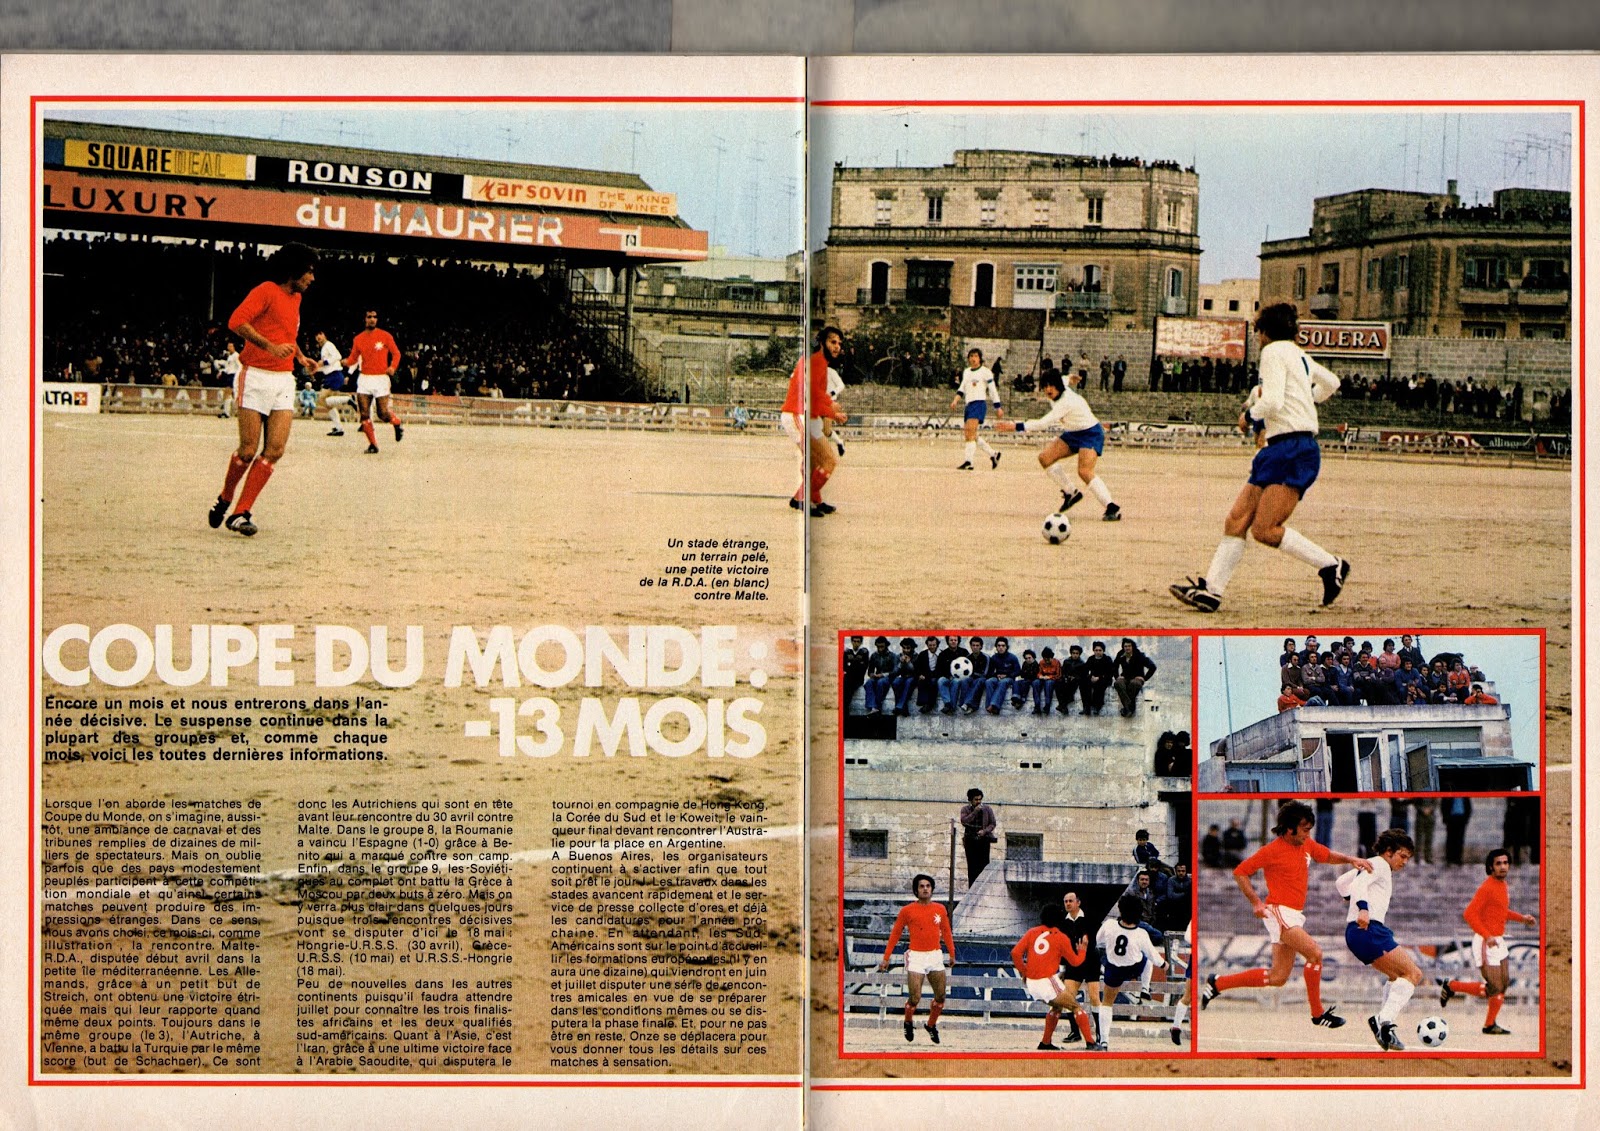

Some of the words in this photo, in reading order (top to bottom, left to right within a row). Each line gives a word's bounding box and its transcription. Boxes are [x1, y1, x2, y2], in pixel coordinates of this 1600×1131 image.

[288, 159, 433, 193] RONSON
[43, 184, 218, 218] LUXURY
[598, 190, 625, 200] THE
[636, 194, 670, 204] KING
[599, 200, 615, 208] OF
[624, 203, 669, 214] WINES
[295, 197, 347, 229] du
[374, 202, 564, 246] MAURIER
[1298, 329, 1381, 348] SOLERA
[43, 390, 73, 405] LTA
[668, 539, 683, 547] Un
[688, 539, 718, 548] stade
[723, 539, 768, 551] étrange,
[701, 552, 737, 561] terrain
[742, 550, 768, 563] pelé,
[691, 565, 722, 576] petite
[728, 565, 768, 574] victoire
[640, 578, 653, 586] de
[658, 577, 667, 586] la
[672, 577, 706, 586] R.D.A.
[712, 578, 729, 589] (en
[734, 578, 769, 589] blanc)
[695, 591, 730, 600] contre
[735, 591, 768, 600] Malte.
[43, 623, 295, 686] COUPE
[315, 624, 424, 687] DU
[45, 697, 98, 710] Encore
[104, 700, 123, 710] un
[129, 697, 164, 710] mois
[170, 697, 186, 710] et
[191, 700, 228, 710] nous
[234, 697, 307, 710] entrerons
[312, 697, 350, 710] dans
[355, 697, 388, 710] l'an-
[45, 714, 73, 727] née
[79, 714, 147, 727] décisive.
[154, 714, 173, 727] Le
[180, 717, 252, 730] suspense
[259, 714, 325, 727] continue
[331, 714, 368, 727] dans
[375, 714, 389, 727] la
[464, 697, 564, 758] -13
[573, 697, 768, 758] MOIS
[45, 731, 99, 747] plupart
[111, 731, 141, 744] des
[154, 734, 217, 747] groupes
[230, 731, 249, 746] et,
[264, 734, 319, 744] comme
[333, 731, 389, 747] chaque
[45, 748, 85, 763] mois,
[90, 748, 127, 762] voici
[132, 748, 154, 762] les
[159, 748, 207, 762] toutes
[212, 748, 284, 762] dernières
[289, 748, 389, 762] informations.
[45, 799, 93, 812] Lorsque
[98, 799, 120, 809] l'on
[125, 799, 166, 809] aborde
[171, 799, 188, 809] les
[193, 799, 243, 809] matches
[247, 799, 262, 809] de
[297, 799, 327, 809] donc
[331, 799, 348, 809] les
[352, 799, 417, 809] Autrichiens
[421, 799, 440, 811] qui
[444, 799, 470, 809] sont
[473, 800, 488, 809] en
[492, 799, 513, 809] tête
[44, 812, 83, 825] Coupe
[84, 812, 100, 822] du
[102, 812, 145, 823] Monde,
[148, 814, 163, 822] on
[165, 812, 224, 825] s'imagine,
[226, 812, 262, 822] aussi-
[297, 824, 333, 835] Malte.
[337, 824, 366, 835] Dans
[369, 824, 380, 835] le
[383, 826, 424, 837] groupe
[427, 824, 438, 836] 8,
[442, 824, 452, 835] la
[455, 824, 513, 835] Roumanie
[44, 838, 93, 848] tribunes
[98, 838, 146, 850] remplies
[152, 838, 167, 848] de
[170, 838, 218, 848] dizaines
[221, 838, 236, 848] de
[239, 838, 262, 848] mil-
[297, 839, 304, 848] a
[308, 837, 347, 848] vaincu
[352, 837, 408, 850] l'Espagne
[412, 837, 439, 850] (1-0)
[444, 837, 477, 850] grâce
[481, 837, 488, 848] à
[493, 837, 513, 848] Be-
[44, 851, 70, 861] liers
[75, 851, 90, 861] de
[95, 851, 165, 863] spectateurs.
[171, 851, 199, 861] Mais
[204, 852, 220, 861] on
[225, 851, 262, 861] oublie
[551, 851, 560, 861] A
[569, 851, 613, 861] Buenos
[620, 851, 654, 862] Aires,
[662, 851, 680, 861] les
[687, 851, 768, 864] organisateurs
[1033, 931, 1050, 955] 6
[1113, 934, 1128, 956] 8
[44, 966, 77, 979] petite
[81, 966, 97, 977] île
[101, 966, 202, 977] méditerranéenne.
[208, 966, 229, 977] Les
[233, 966, 261, 977] Alle-
[297, 992, 358, 1002] continents
[365, 992, 414, 1004] puisqu'il
[420, 992, 459, 1002] faudra
[465, 992, 513, 1002] attendre
[550, 992, 572, 1003] tres
[577, 992, 628, 1003] amicales
[633, 994, 648, 1003] en
[653, 994, 674, 1003] vue
[679, 992, 694, 1003] de
[699, 994, 713, 1003] se
[717, 992, 767, 1005] préparer
[297, 1004, 329, 1017] juillet
[333, 1006, 360, 1017] pour
[364, 1004, 419, 1015] connaître
[423, 1004, 440, 1015] les
[443, 1004, 470, 1015] trois
[473, 1004, 513, 1015] finalis-
[549, 1045, 578, 1054] vous
[582, 1044, 624, 1054] donner
[628, 1044, 654, 1054] tous
[659, 1044, 676, 1054] les
[680, 1044, 719, 1054] détails
[723, 1045, 742, 1054] sur
[747, 1045, 767, 1054] ces
[550, 1057, 599, 1067] matches
[602, 1057, 610, 1067] à
[612, 1057, 672, 1067] sensation.
